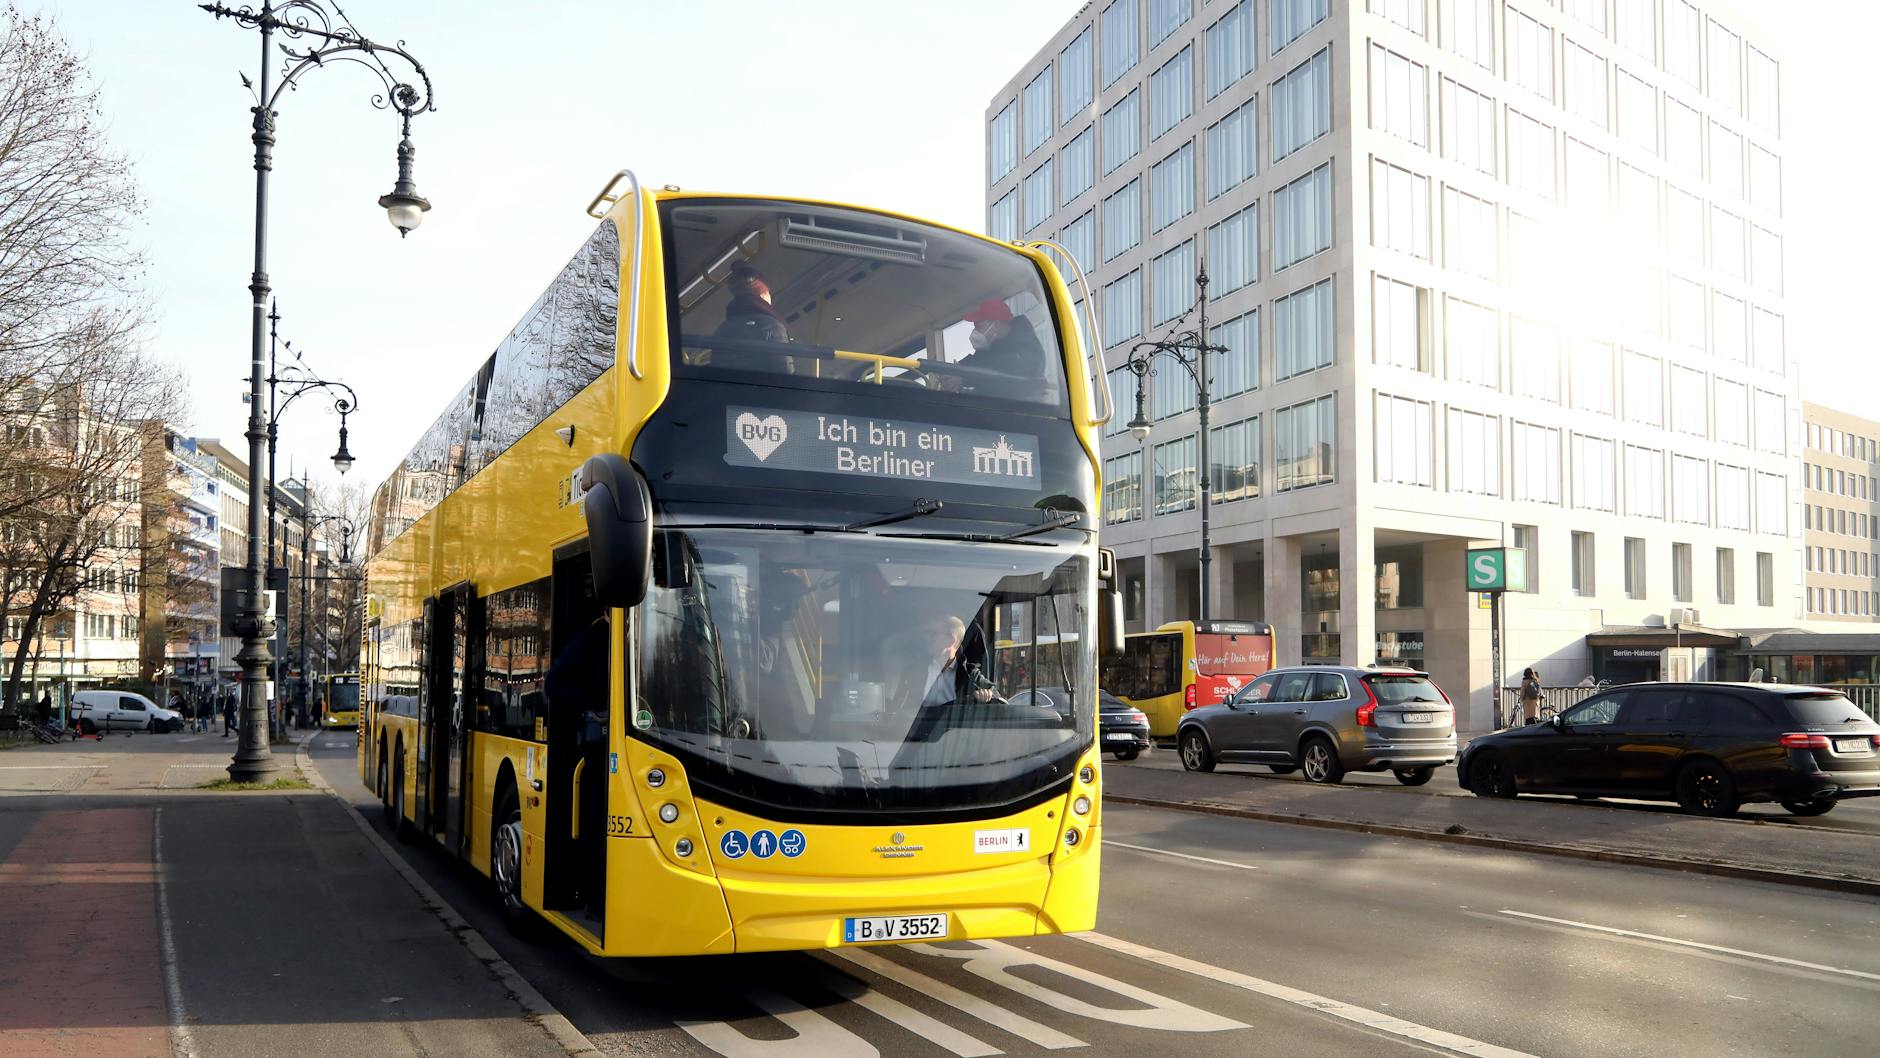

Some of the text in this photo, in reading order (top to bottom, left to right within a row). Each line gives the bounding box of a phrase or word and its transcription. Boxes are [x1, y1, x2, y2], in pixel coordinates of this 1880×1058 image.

[742, 423, 781, 442] BVG
[818, 416, 952, 452] Ich bin ein
[837, 446, 935, 478] Berliner
[1474, 555, 1497, 585] S
[978, 836, 1008, 846] BERLIN
[862, 917, 940, 938] B V 3552
